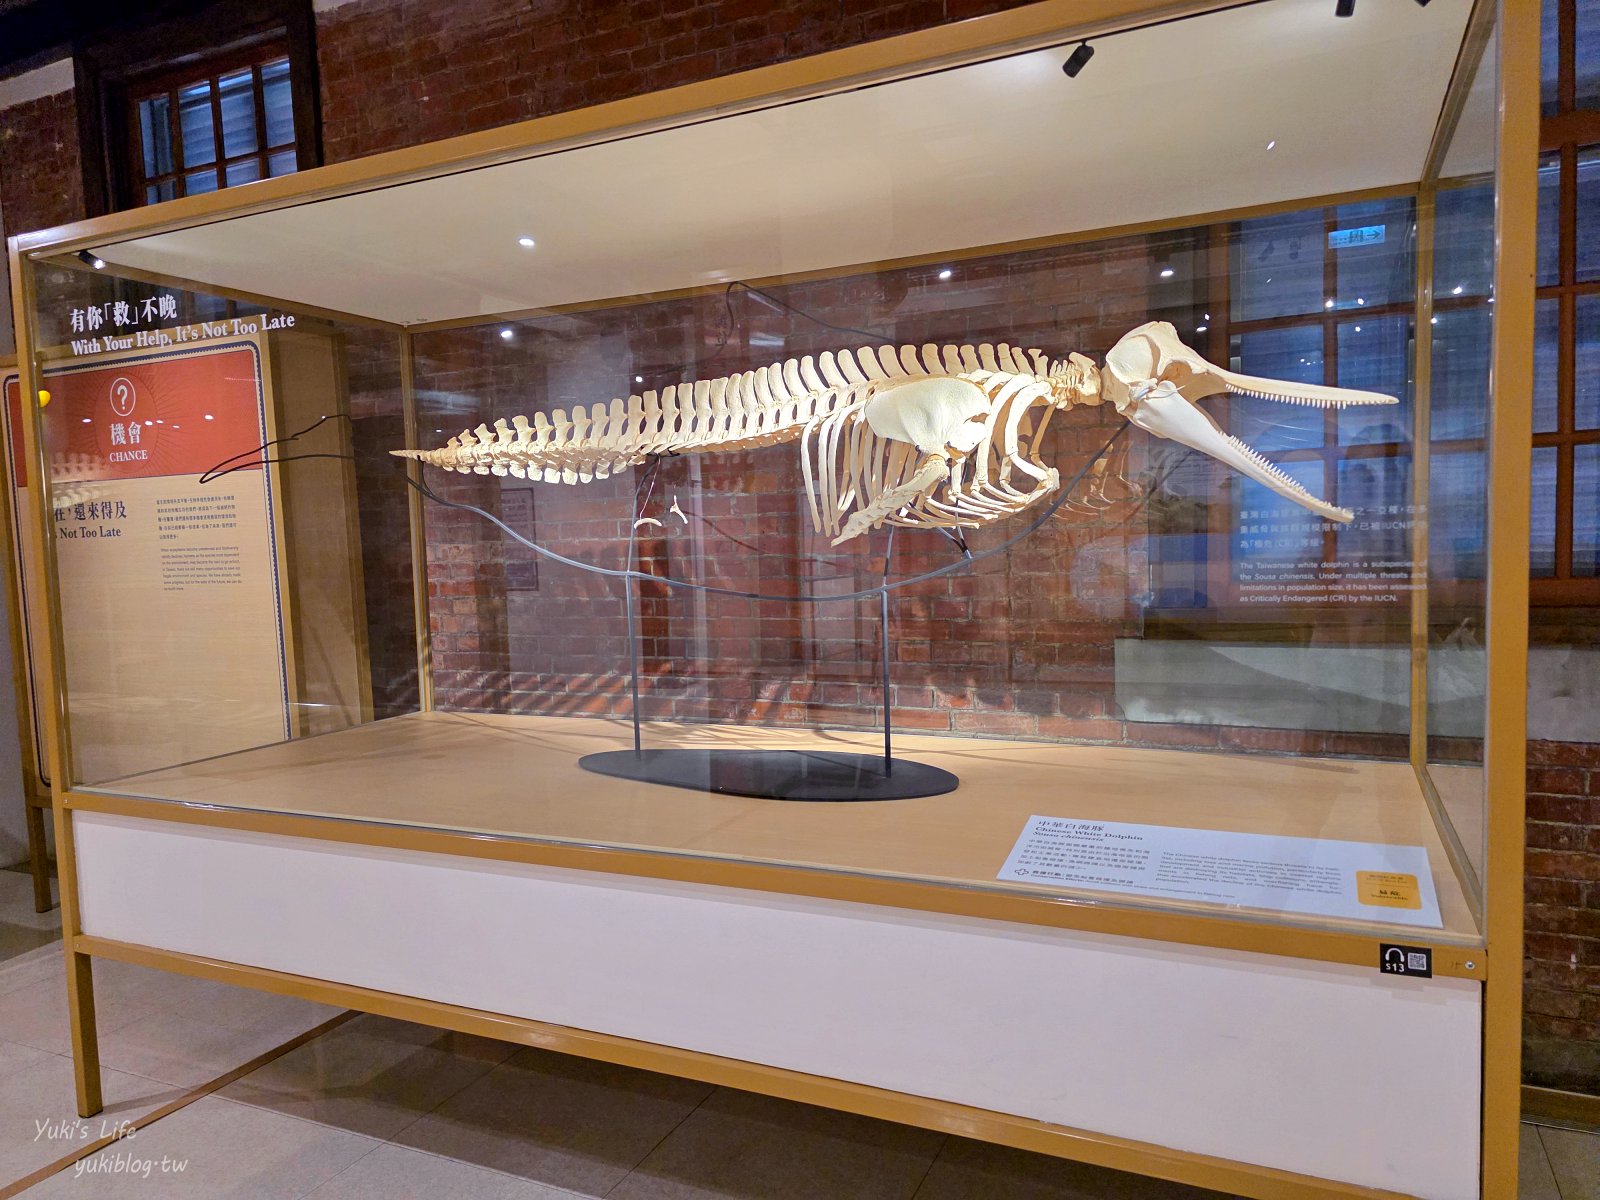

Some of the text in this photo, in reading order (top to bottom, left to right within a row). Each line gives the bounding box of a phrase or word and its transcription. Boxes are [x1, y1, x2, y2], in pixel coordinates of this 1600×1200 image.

[70, 294, 178, 334] 有你「救」不晚
[71, 339, 102, 356] With
[103, 335, 133, 351] Your
[136, 329, 173, 348] Help,
[202, 321, 229, 338] Not
[231, 318, 258, 335] Too
[261, 313, 295, 330] Late
[109, 421, 141, 446] 機會
[109, 449, 148, 463] CHANCE
[60, 525, 122, 539] Not Too Late
[1240, 562, 1252, 570] The
[1257, 561, 1295, 569] Taiwanese
[1298, 561, 1318, 569] white
[1321, 561, 1350, 570] dolphin
[1240, 573, 1252, 581] the
[1254, 573, 1276, 581] Sousa
[1319, 572, 1343, 580] Under
[1346, 572, 1377, 581] multiple
[1240, 584, 1278, 592] limitations
[1287, 584, 1327, 593] population
[1352, 583, 1367, 591] has
[1369, 583, 1389, 591] been
[1250, 594, 1281, 604] Critically
[1282, 594, 1328, 604] Endangered
[1330, 594, 1347, 604] (CR)
[1348, 594, 1358, 604] by
[1360, 594, 1373, 603] the
[1061, 834, 1105, 842] chinensis
[1075, 829, 1102, 837] White
[1104, 832, 1144, 841] Dolphin
[1385, 962, 1405, 972] S13
